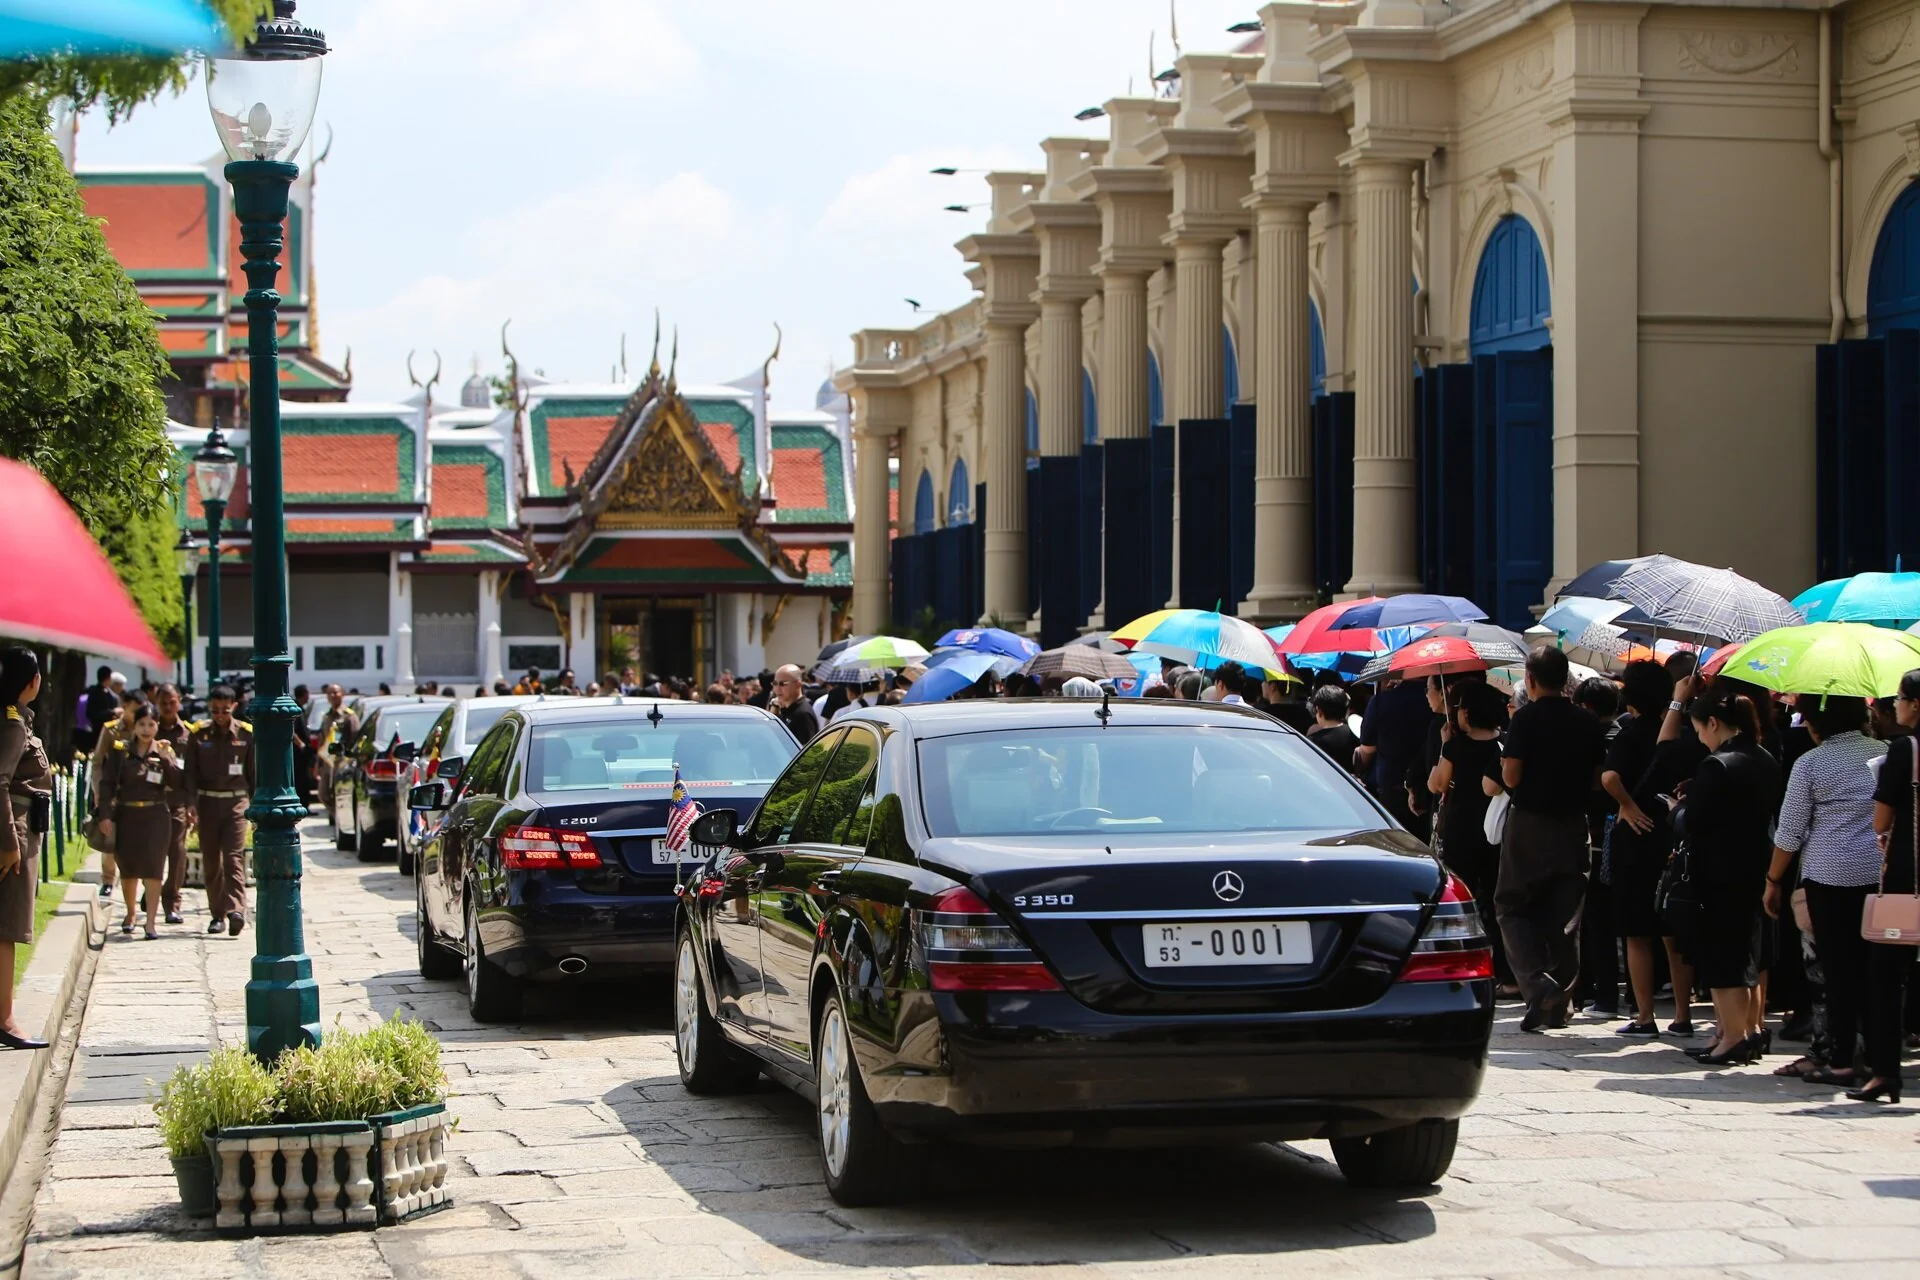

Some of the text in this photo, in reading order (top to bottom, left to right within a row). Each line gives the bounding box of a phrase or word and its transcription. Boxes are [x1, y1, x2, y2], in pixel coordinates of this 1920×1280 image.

[571, 817, 598, 825] 200
[659, 851, 671, 862] 57
[1014, 894, 1074, 906] S 350
[1159, 946, 1181, 962] 53
